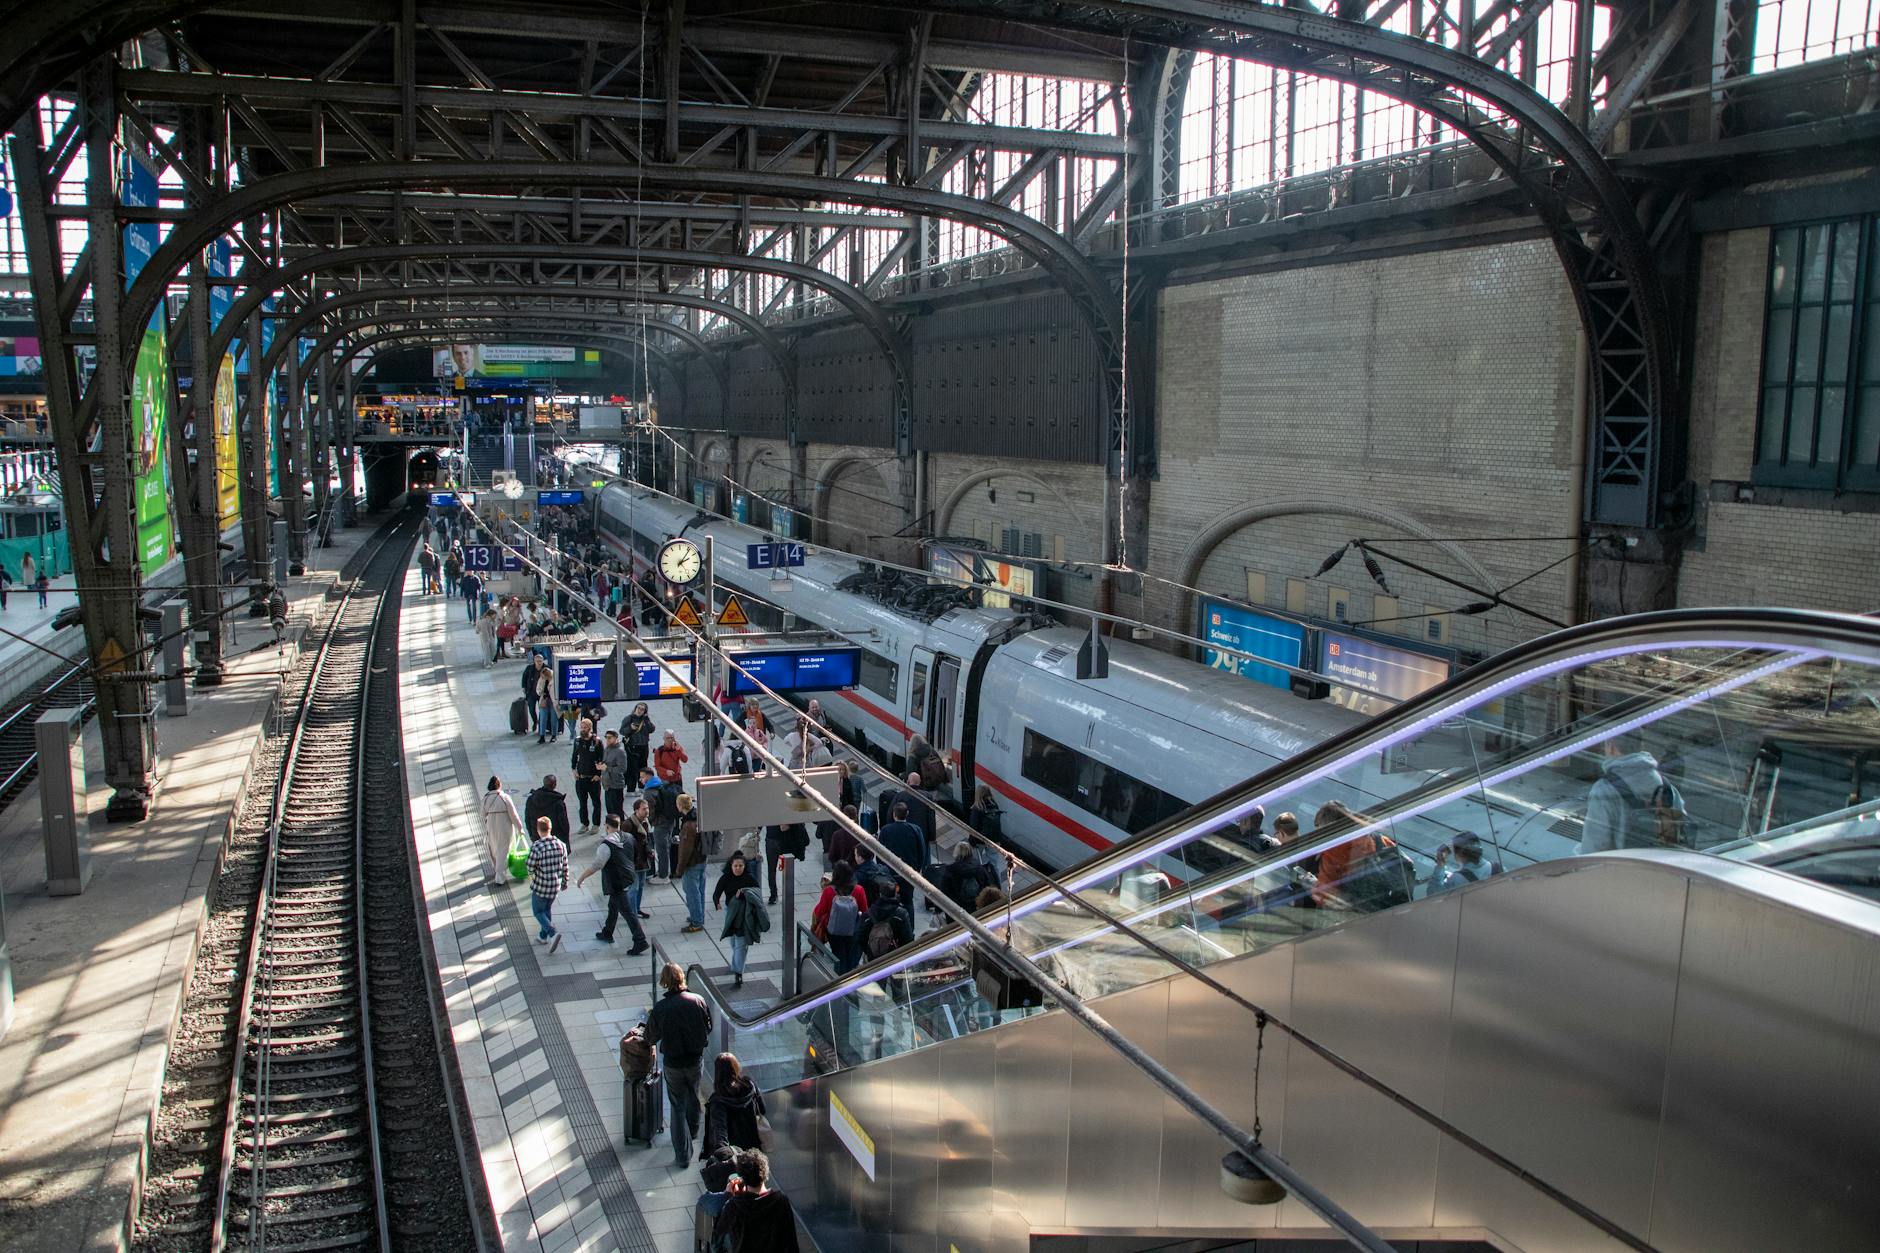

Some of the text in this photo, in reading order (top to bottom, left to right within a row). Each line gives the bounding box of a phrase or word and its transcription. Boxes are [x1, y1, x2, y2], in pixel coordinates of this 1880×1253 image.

[468, 547, 490, 566] 13
[757, 543, 802, 565] E 14
[1211, 628, 1240, 645] Schweiz ab
[1330, 643, 1340, 656] DB
[568, 675, 589, 683] Ankunft
[1328, 660, 1377, 682] Amsterdam ab
